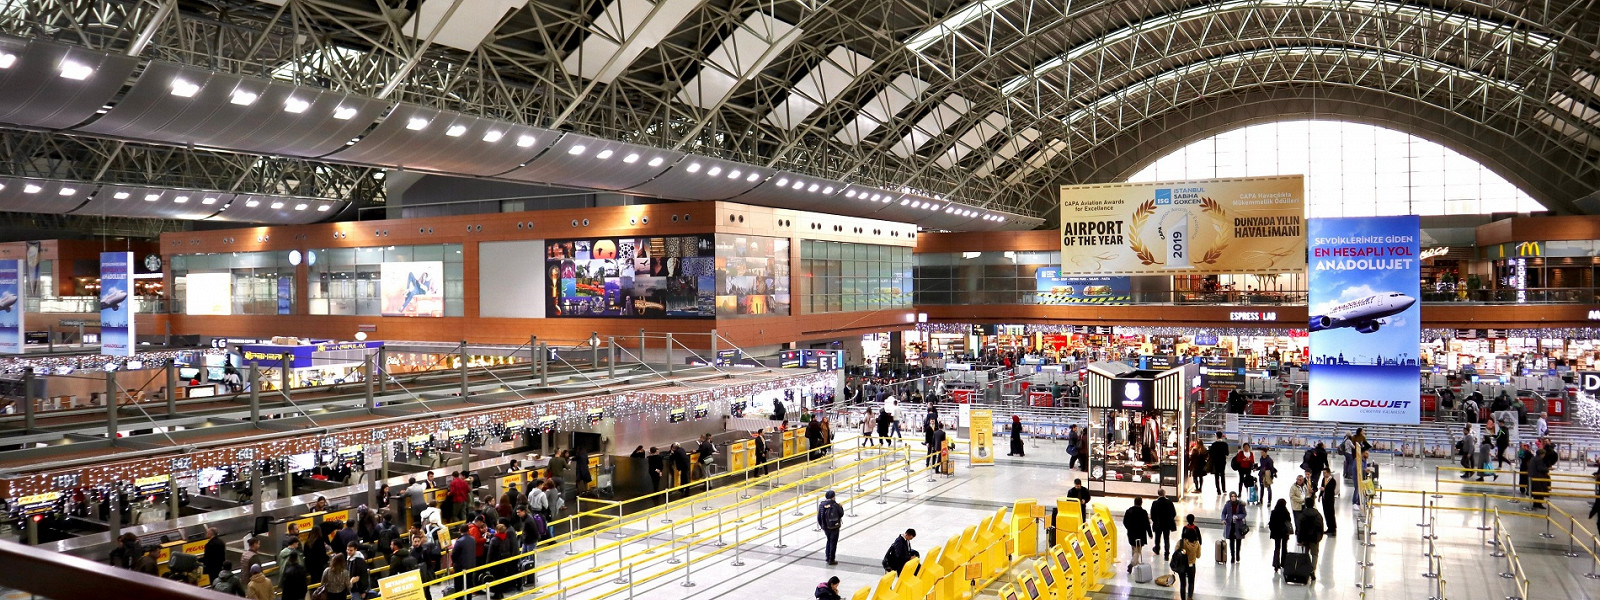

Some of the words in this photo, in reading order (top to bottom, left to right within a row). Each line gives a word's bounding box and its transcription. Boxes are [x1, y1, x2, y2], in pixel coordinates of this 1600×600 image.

[1276, 215, 1300, 226] YILIN
[1064, 220, 1124, 236] AIRPORT
[1063, 236, 1076, 246] OF
[1078, 235, 1097, 246] THE
[1098, 235, 1124, 246] YEAR
[1172, 231, 1183, 259] 2019
[1315, 236, 1384, 245] SEVDİKLERİNİZE
[1385, 235, 1413, 243] GİDEN
[1315, 248, 1330, 257] EN
[1333, 247, 1384, 257] HESAPLI
[1387, 246, 1413, 256] YOL
[1315, 259, 1413, 270] ANADOLUJET
[820, 357, 827, 370] E
[1585, 374, 1600, 390] D
[1317, 398, 1411, 408] ANADOLUJET
